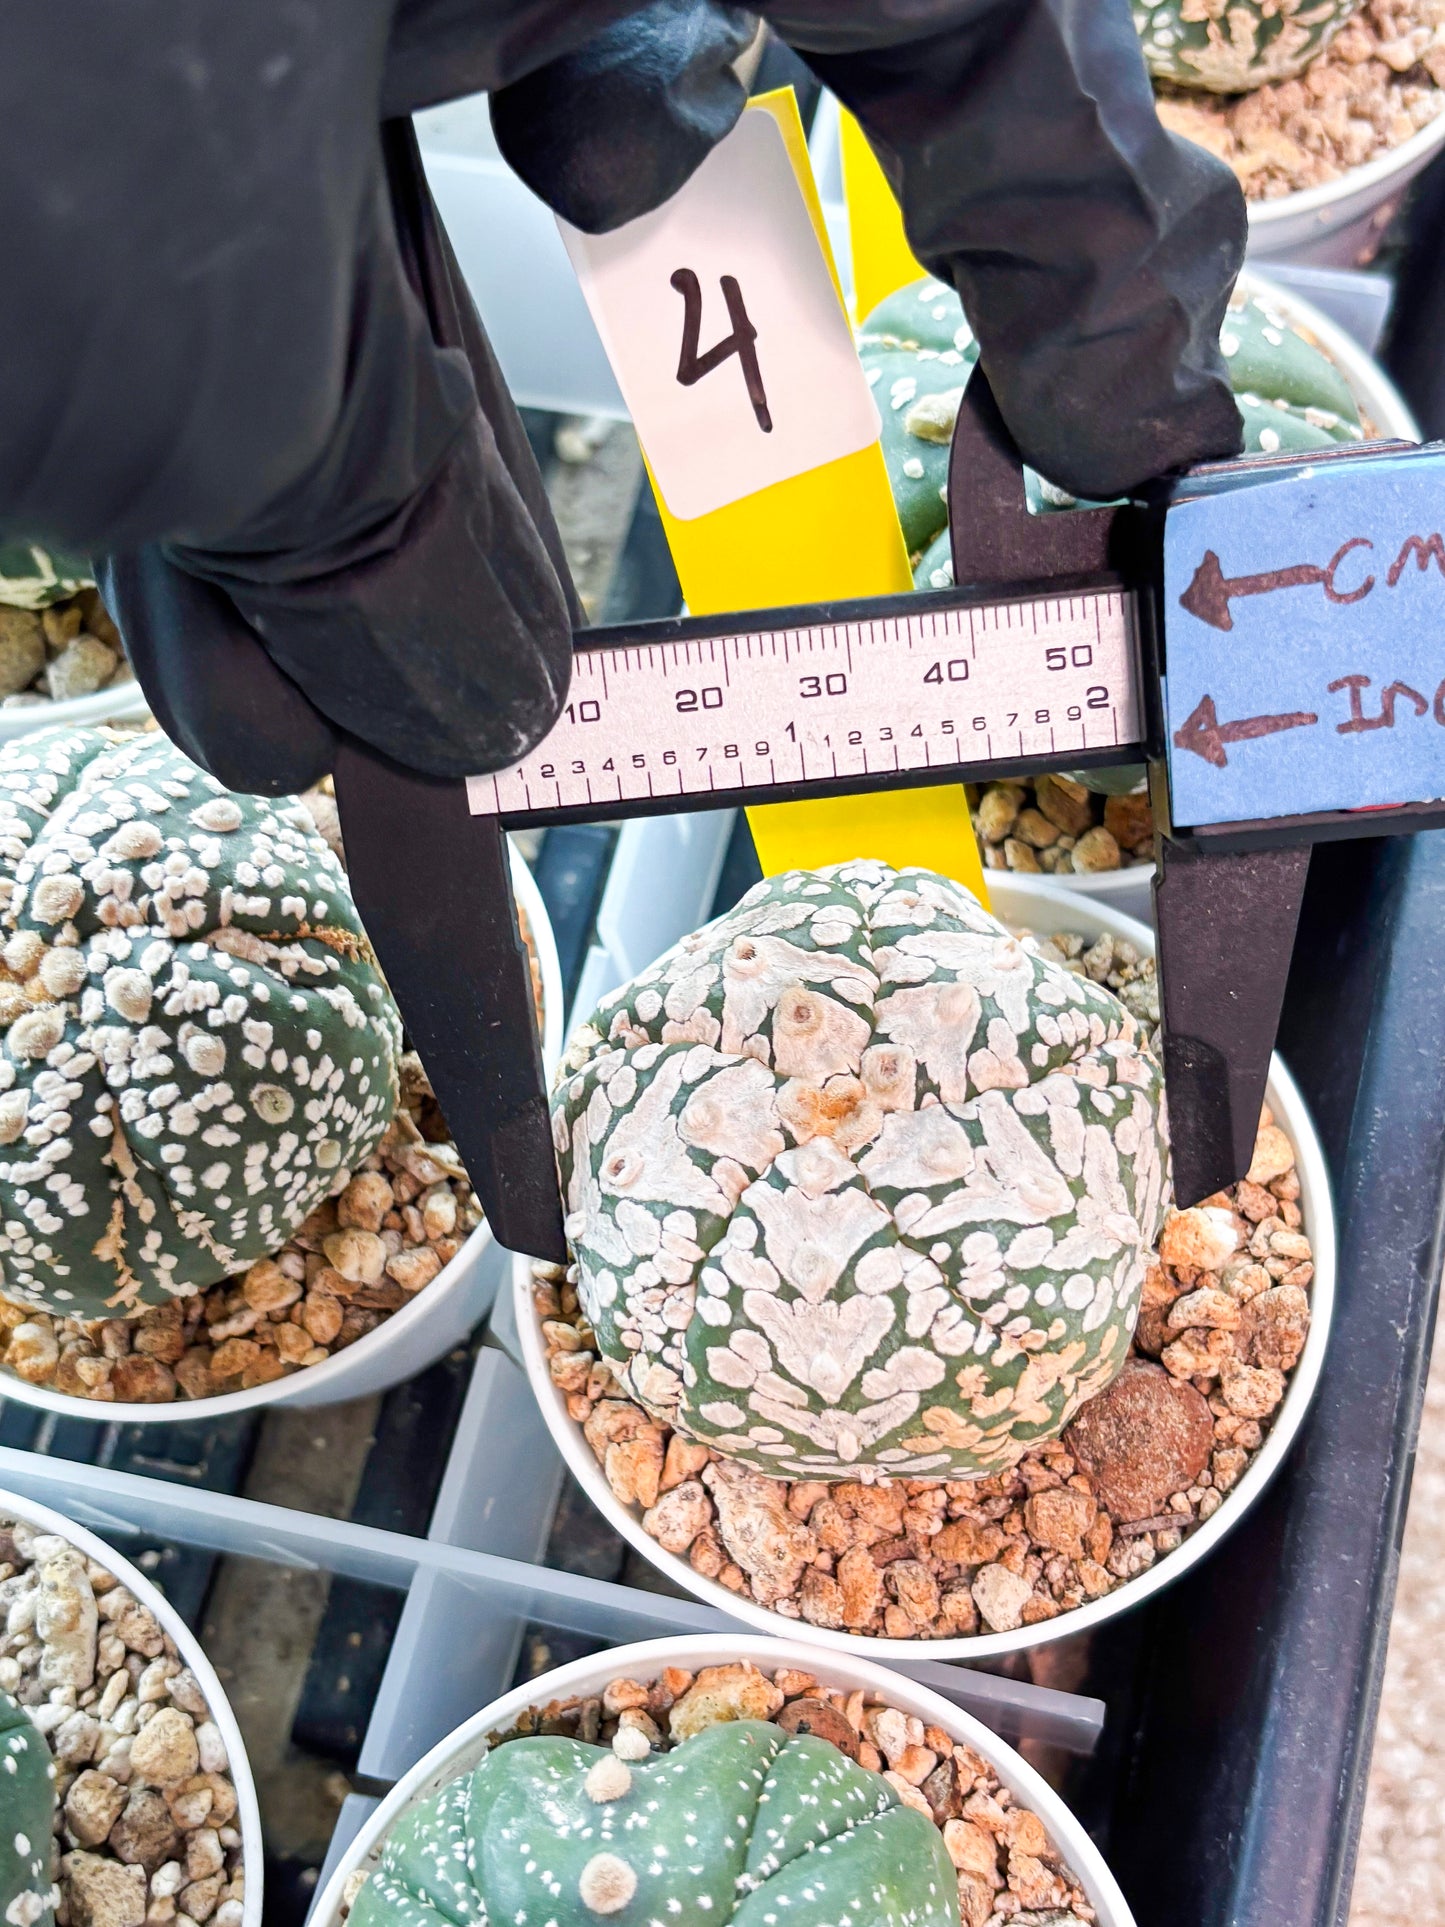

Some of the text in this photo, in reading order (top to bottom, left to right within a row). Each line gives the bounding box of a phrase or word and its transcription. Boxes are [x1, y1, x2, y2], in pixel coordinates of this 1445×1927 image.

[669, 267, 773, 434] 4
[564, 644, 1093, 725] 10 20 30 40 50
[540, 763, 556, 779] 2
[571, 760, 586, 774] 3
[602, 757, 615, 772] 4
[631, 753, 646, 769] 5
[662, 750, 677, 766] 6
[696, 747, 708, 762] 7
[723, 744, 739, 759] 8
[755, 741, 770, 756] 9
[847, 730, 863, 746] 2
[879, 727, 894, 741] 3
[910, 723, 923, 738] 4
[941, 719, 954, 735] 5
[972, 716, 987, 731] 6
[1006, 712, 1019, 727] 7
[1035, 709, 1050, 724] 8
[1066, 705, 1082, 721] 9
[1086, 685, 1110, 710] 2
